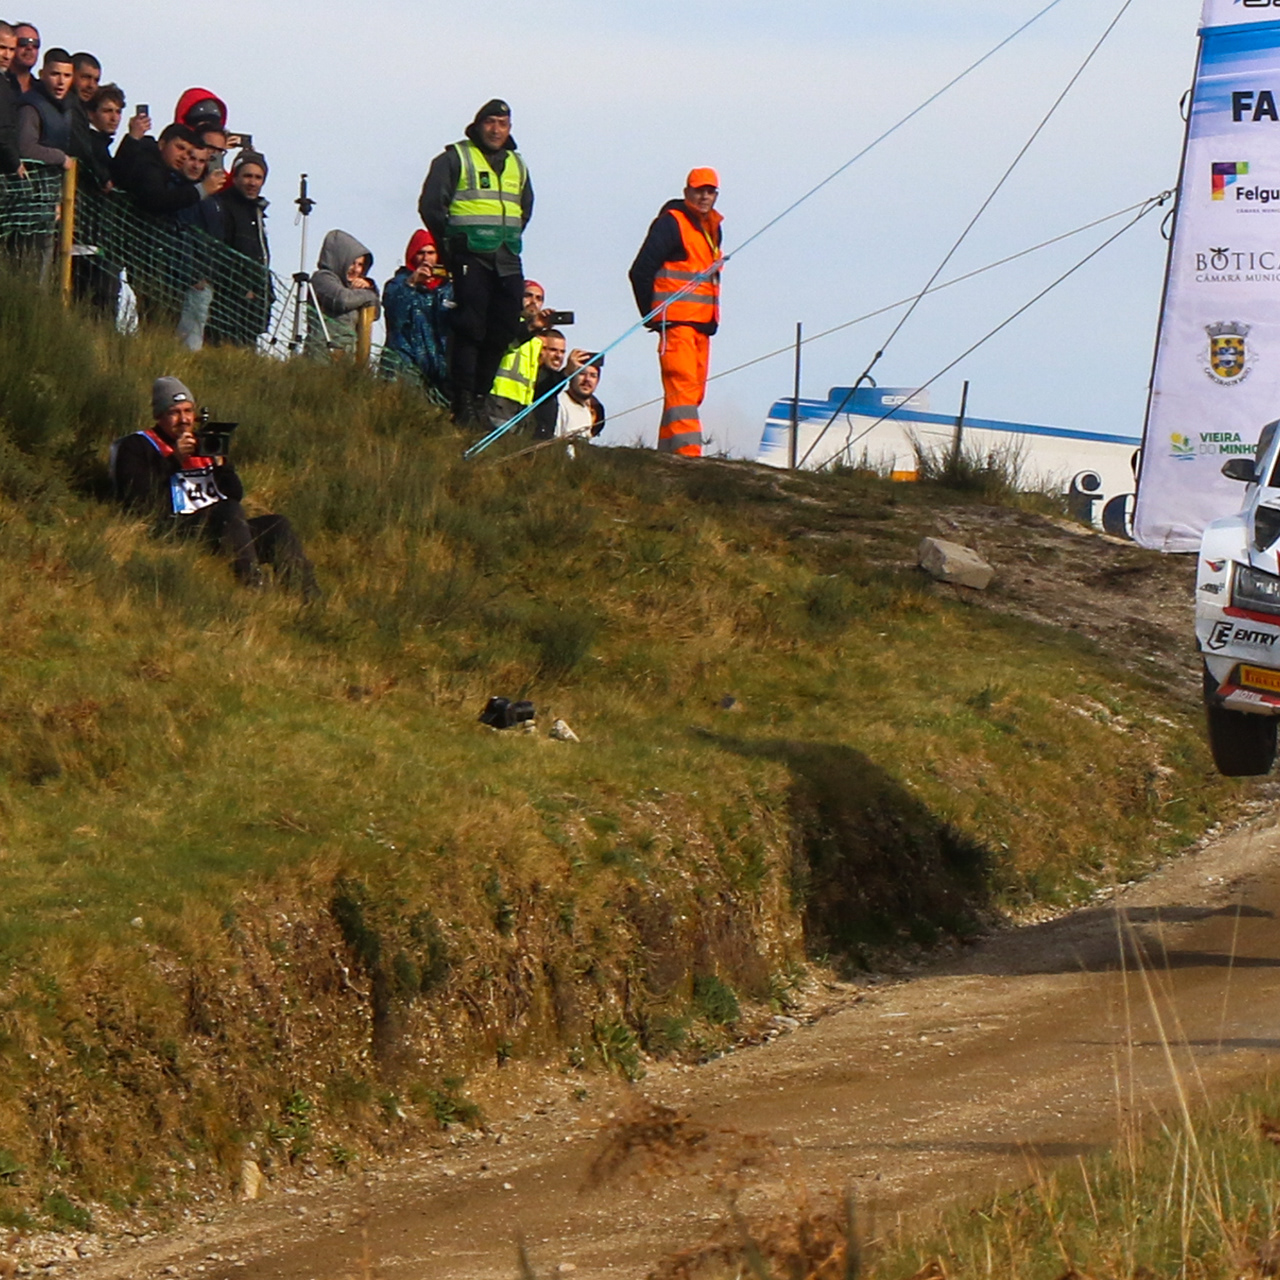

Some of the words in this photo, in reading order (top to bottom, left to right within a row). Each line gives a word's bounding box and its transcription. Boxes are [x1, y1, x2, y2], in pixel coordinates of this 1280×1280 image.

[1199, 432, 1242, 442] VIEIRA
[1199, 444, 1217, 455] DO
[1234, 629, 1280, 646] ENTRY
